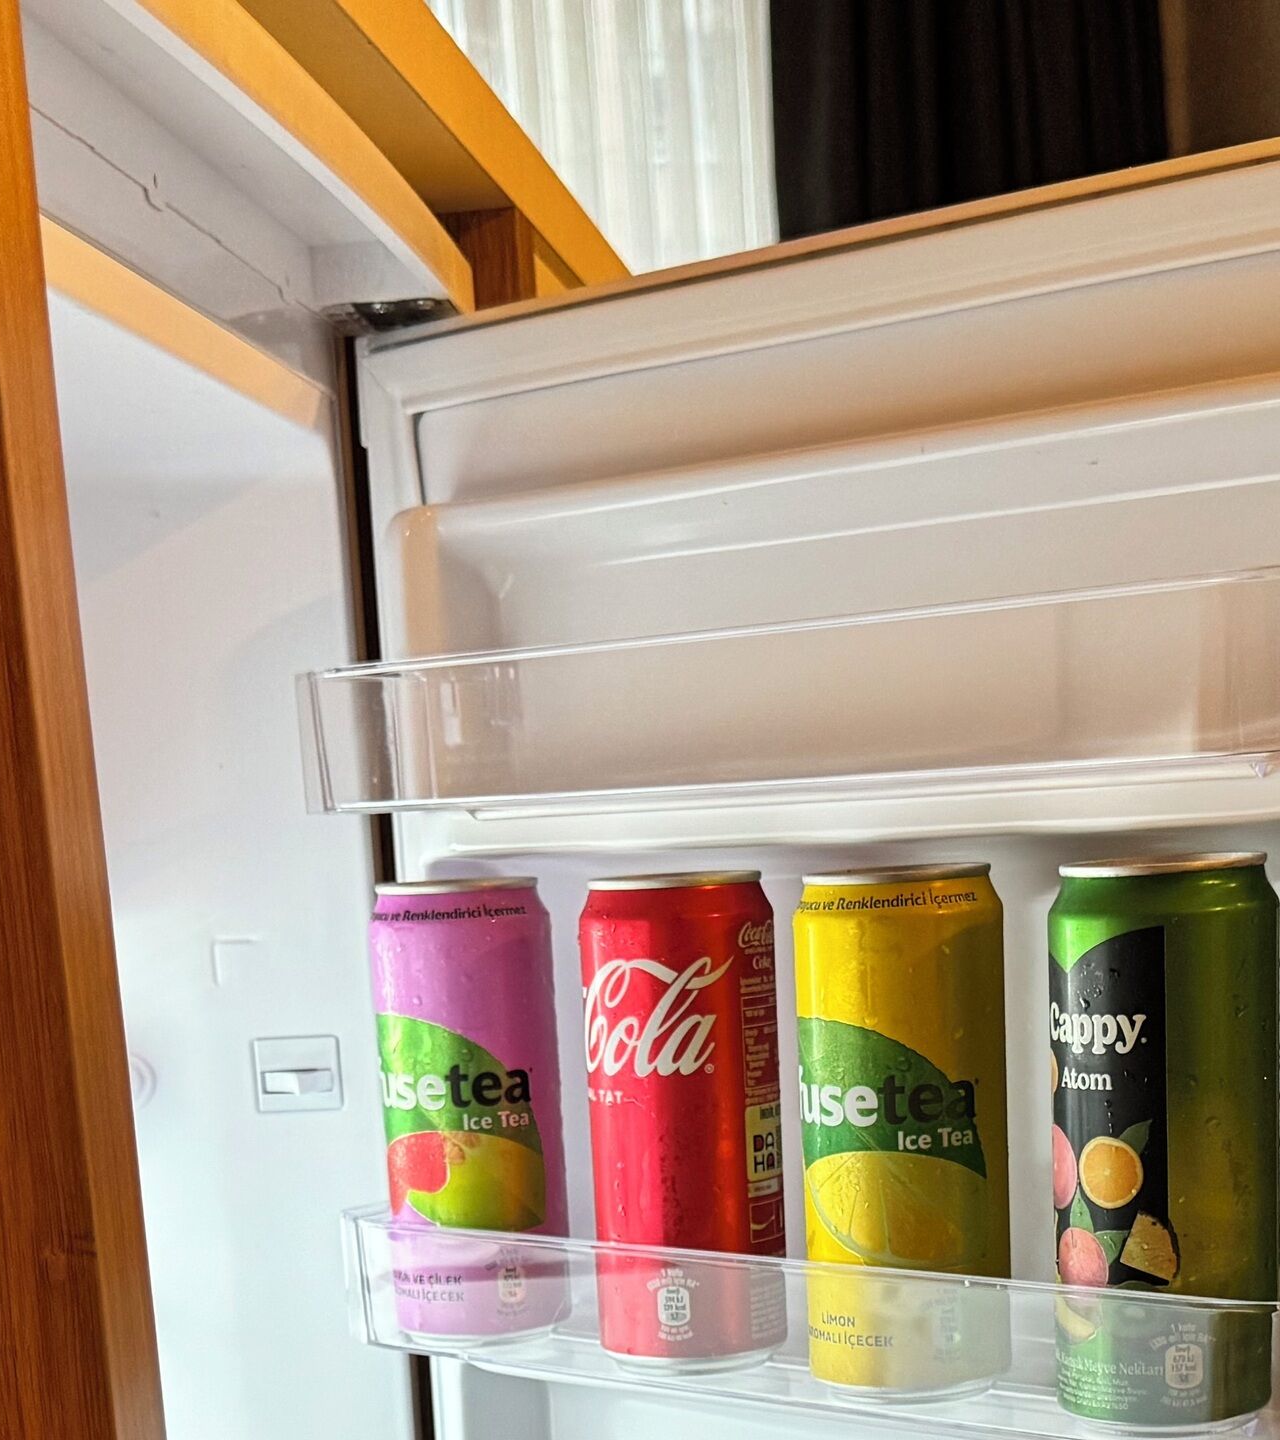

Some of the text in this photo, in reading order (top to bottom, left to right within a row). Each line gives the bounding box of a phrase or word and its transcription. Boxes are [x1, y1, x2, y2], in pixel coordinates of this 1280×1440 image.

[822, 901, 834, 910] ve
[836, 891, 926, 910] Renklendirici
[928, 889, 977, 908] İçermez
[402, 907, 481, 921] Renklendirici
[483, 904, 527, 918] İçermez
[1050, 1001, 1147, 1055] Cappy
[379, 1059, 531, 1111] usetea
[1061, 1066, 1113, 1091] Atom
[463, 1110, 529, 1131] Ice Tea
[897, 1127, 973, 1151] Ice Tea
[421, 1289, 465, 1304] İÇECEK
[821, 1311, 856, 1328] LİMON
[844, 1330, 893, 1350] İÇECEK
[1085, 1358, 1117, 1375] Meyve
